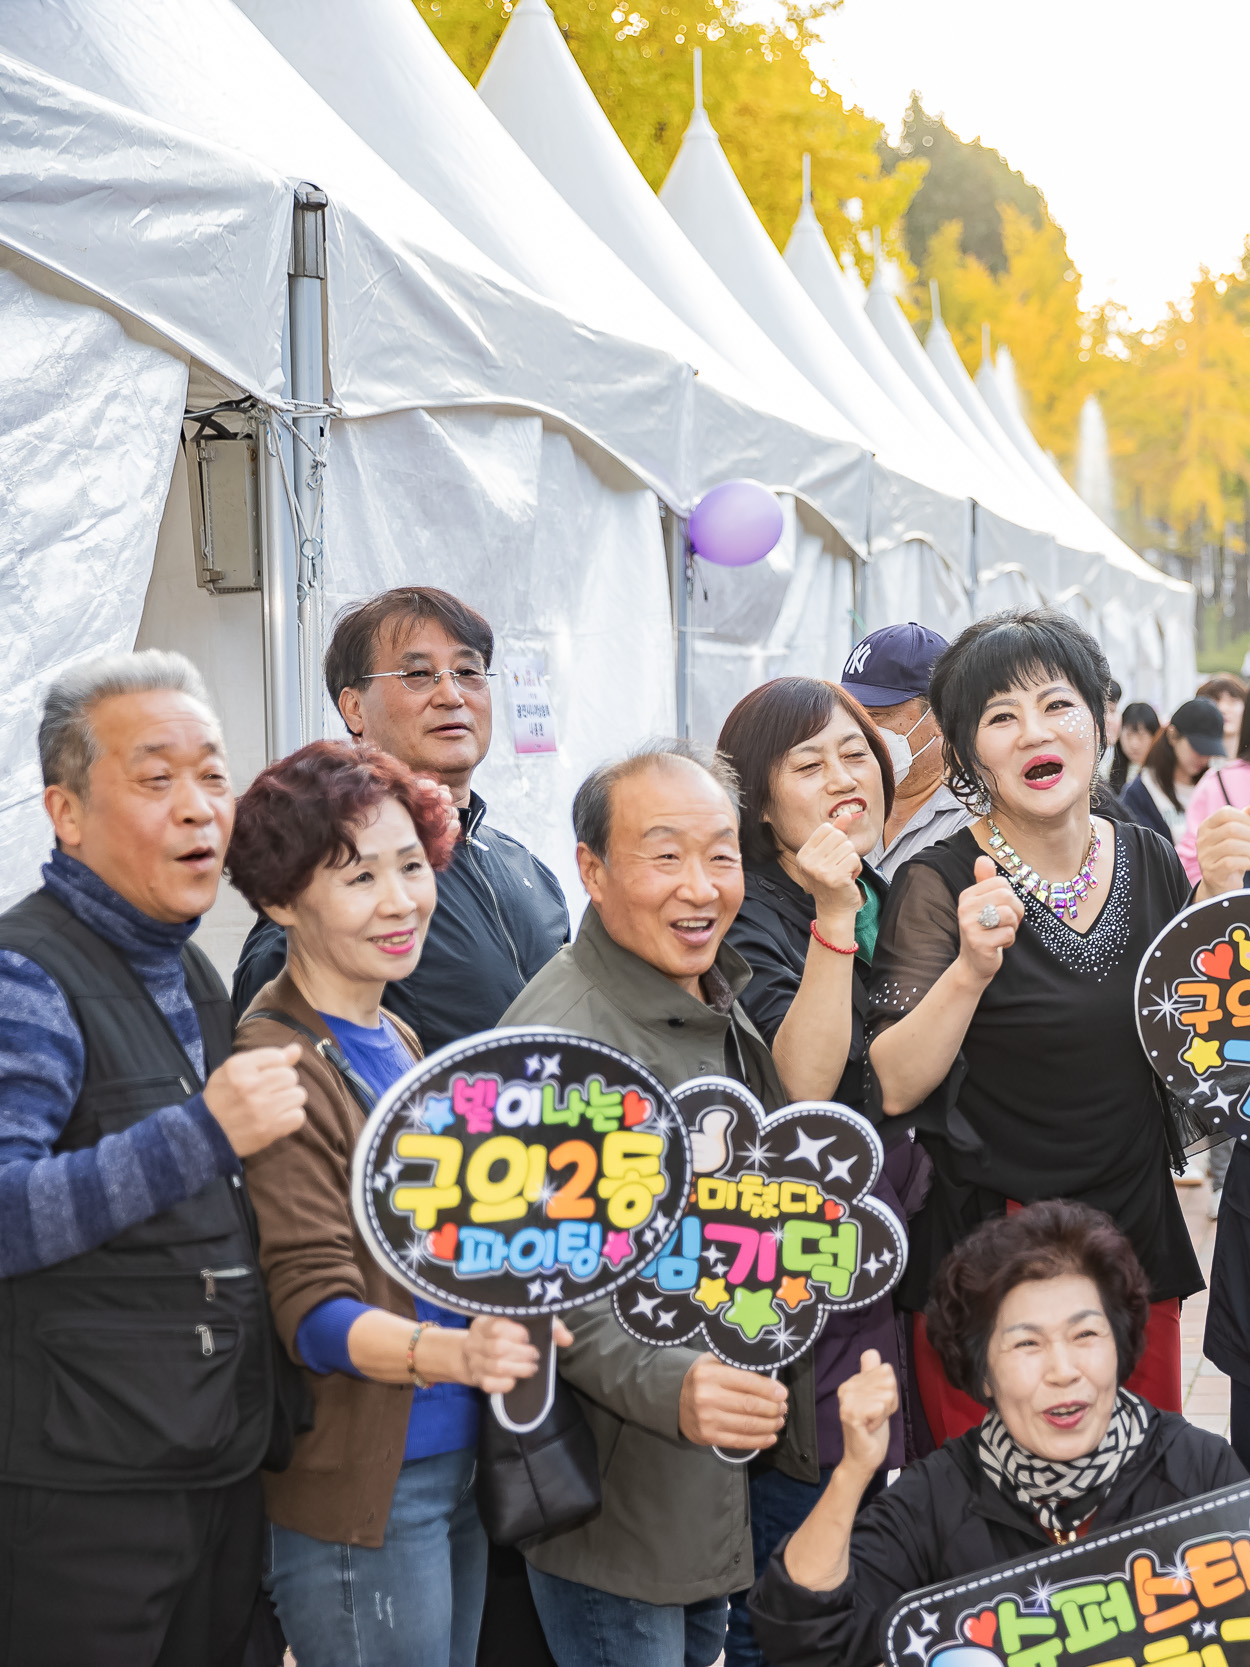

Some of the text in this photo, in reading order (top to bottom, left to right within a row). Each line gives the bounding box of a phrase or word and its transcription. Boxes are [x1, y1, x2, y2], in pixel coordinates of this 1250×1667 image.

[844, 643, 872, 675] NY
[452, 1076, 624, 1135] 빛이나는
[393, 1130, 668, 1231] 구의2동
[689, 1174, 824, 1219] 미쳤다
[457, 1221, 602, 1278] 파이팅
